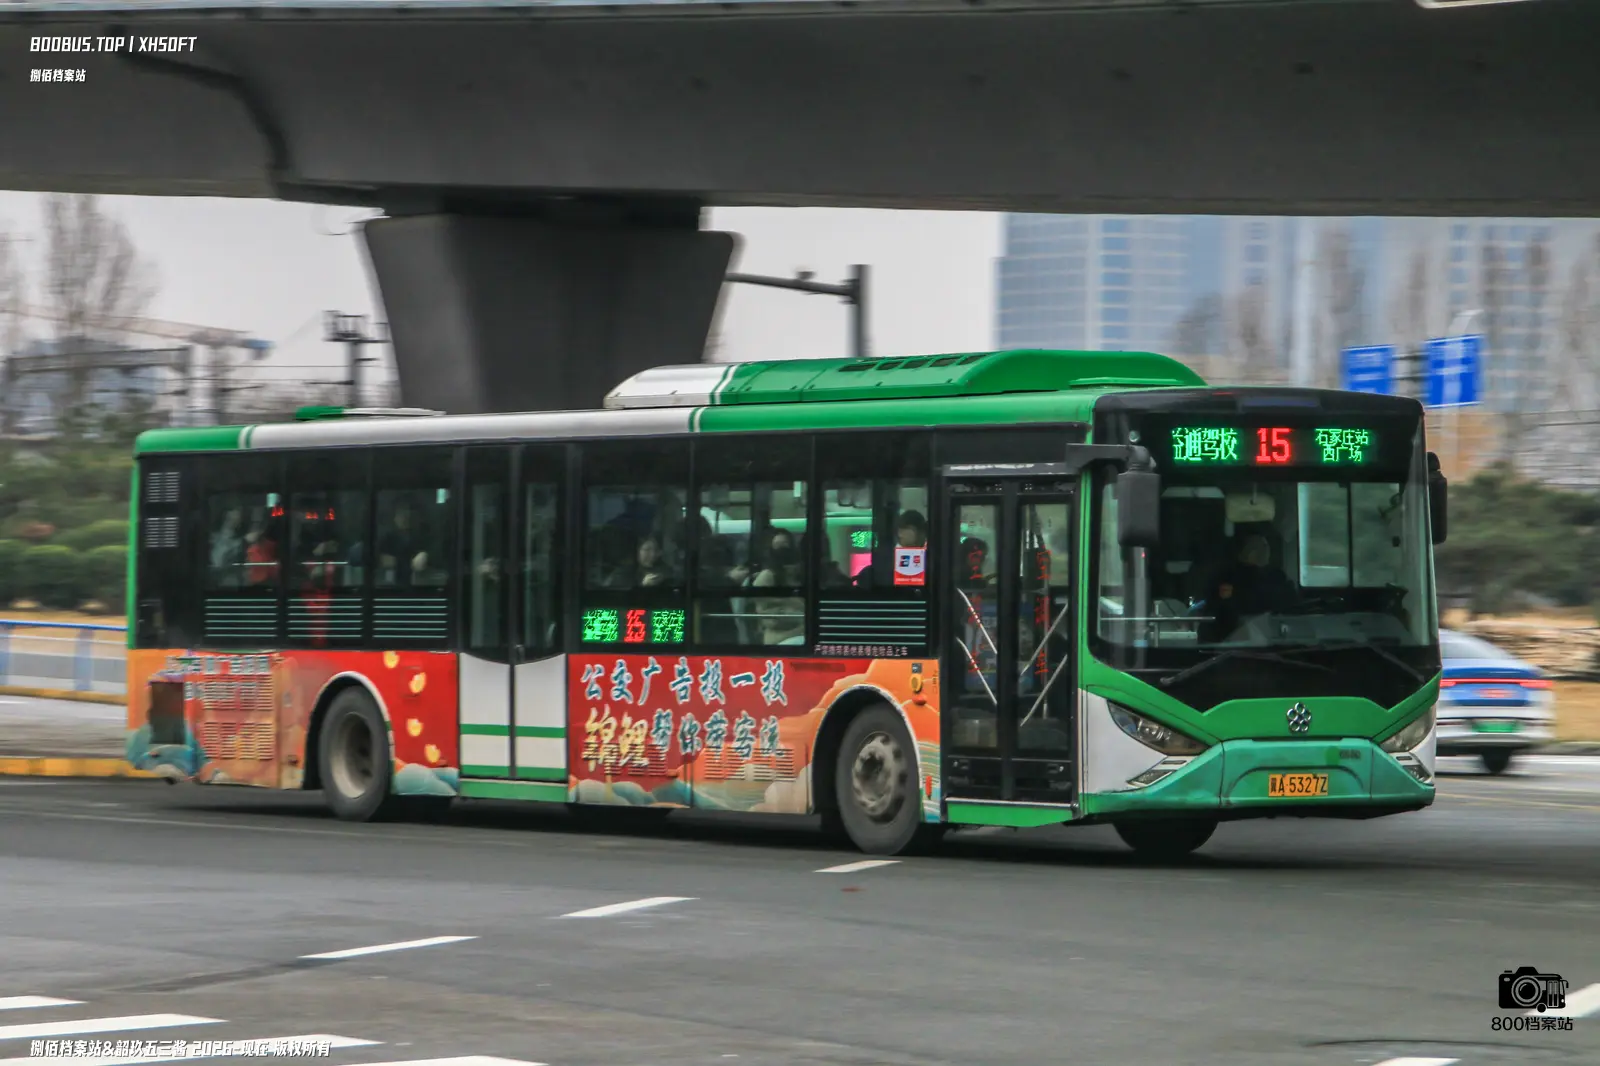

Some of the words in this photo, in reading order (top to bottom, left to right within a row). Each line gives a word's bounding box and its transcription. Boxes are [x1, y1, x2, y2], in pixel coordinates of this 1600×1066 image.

[1256, 428, 1292, 462] 15
[1315, 428, 1369, 445] 石家庄站
[1323, 444, 1363, 462] 西广场
[580, 656, 788, 706] 公交广告投一投
